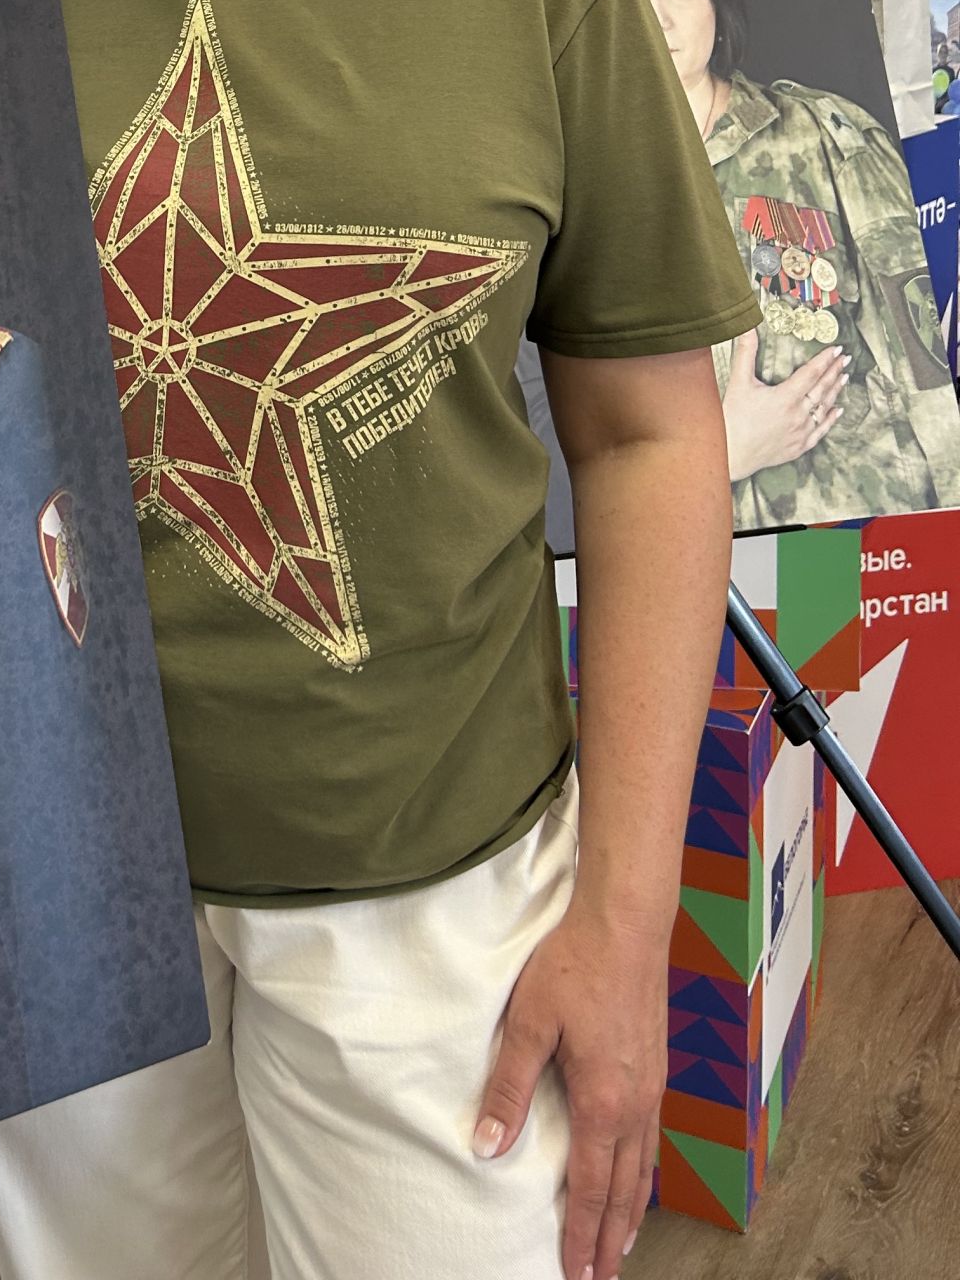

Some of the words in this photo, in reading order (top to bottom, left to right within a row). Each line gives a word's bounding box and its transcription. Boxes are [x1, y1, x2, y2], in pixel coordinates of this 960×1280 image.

[326, 407, 347, 433] В
[342, 375, 393, 422] ТЕБЕ
[388, 340, 434, 392] ТЕЧЕТ
[435, 309, 489, 354] КРОВЬ
[342, 354, 457, 459] ПОБЕДИТЕЛЕЙ
[860, 590, 948, 628] рстан
